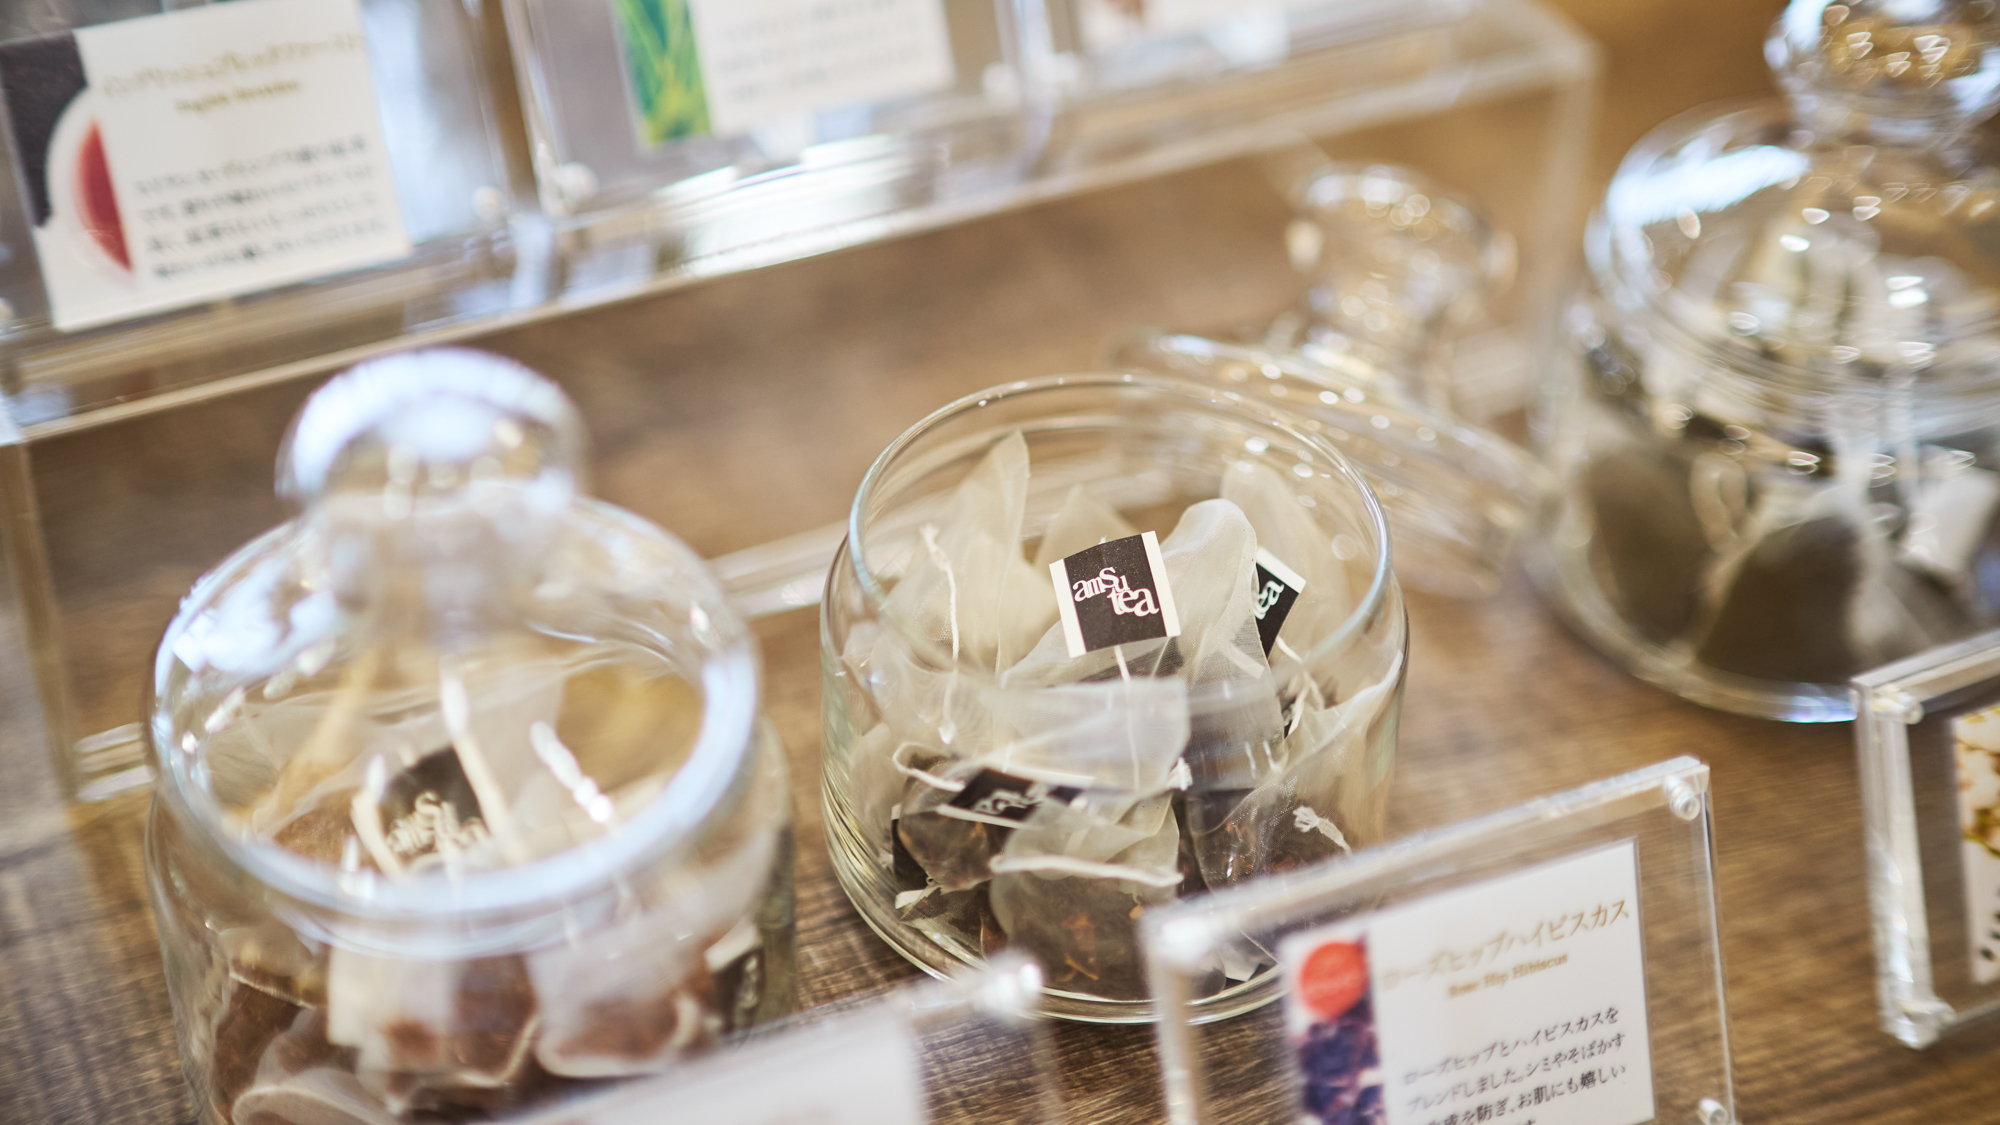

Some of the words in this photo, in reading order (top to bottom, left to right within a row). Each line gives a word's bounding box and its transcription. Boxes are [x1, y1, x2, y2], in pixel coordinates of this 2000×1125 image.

[1107, 588, 1159, 617] tea
[1254, 580, 1285, 620] ea
[1484, 972, 1509, 990] Hip
[1512, 953, 1569, 981] Hibiscus
[1404, 1006, 1620, 1085] ローズヒップとハイビスカスを
[1406, 1032, 1626, 1117] ブレンドしました。シミやそばかす
